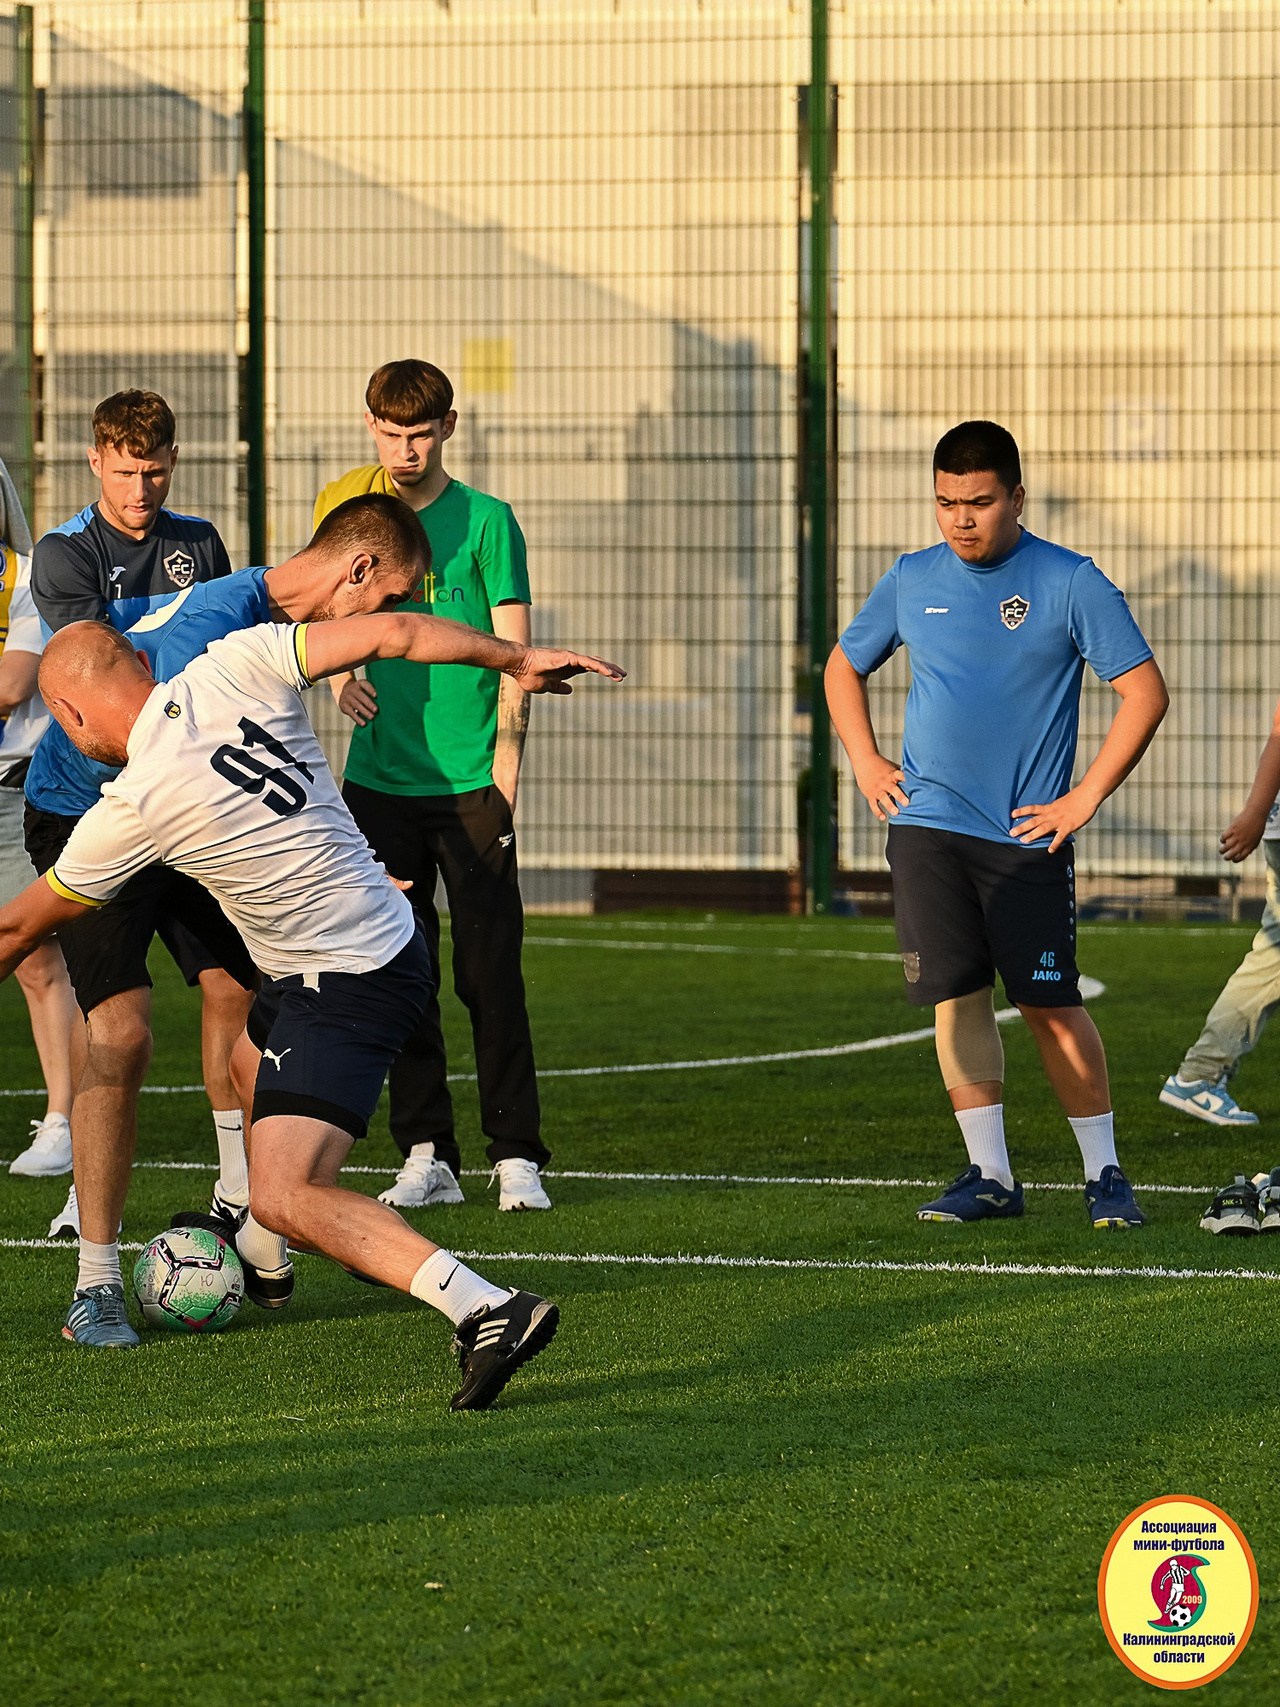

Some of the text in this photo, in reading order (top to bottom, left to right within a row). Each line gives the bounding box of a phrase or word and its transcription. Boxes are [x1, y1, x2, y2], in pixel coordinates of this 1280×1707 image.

[171, 563, 190, 575] FC
[413, 571, 464, 604] etton
[1005, 607, 1024, 618] FC
[210, 715, 315, 818] 91
[1039, 951, 1055, 968] 46
[1031, 970, 1062, 982] JAKO
